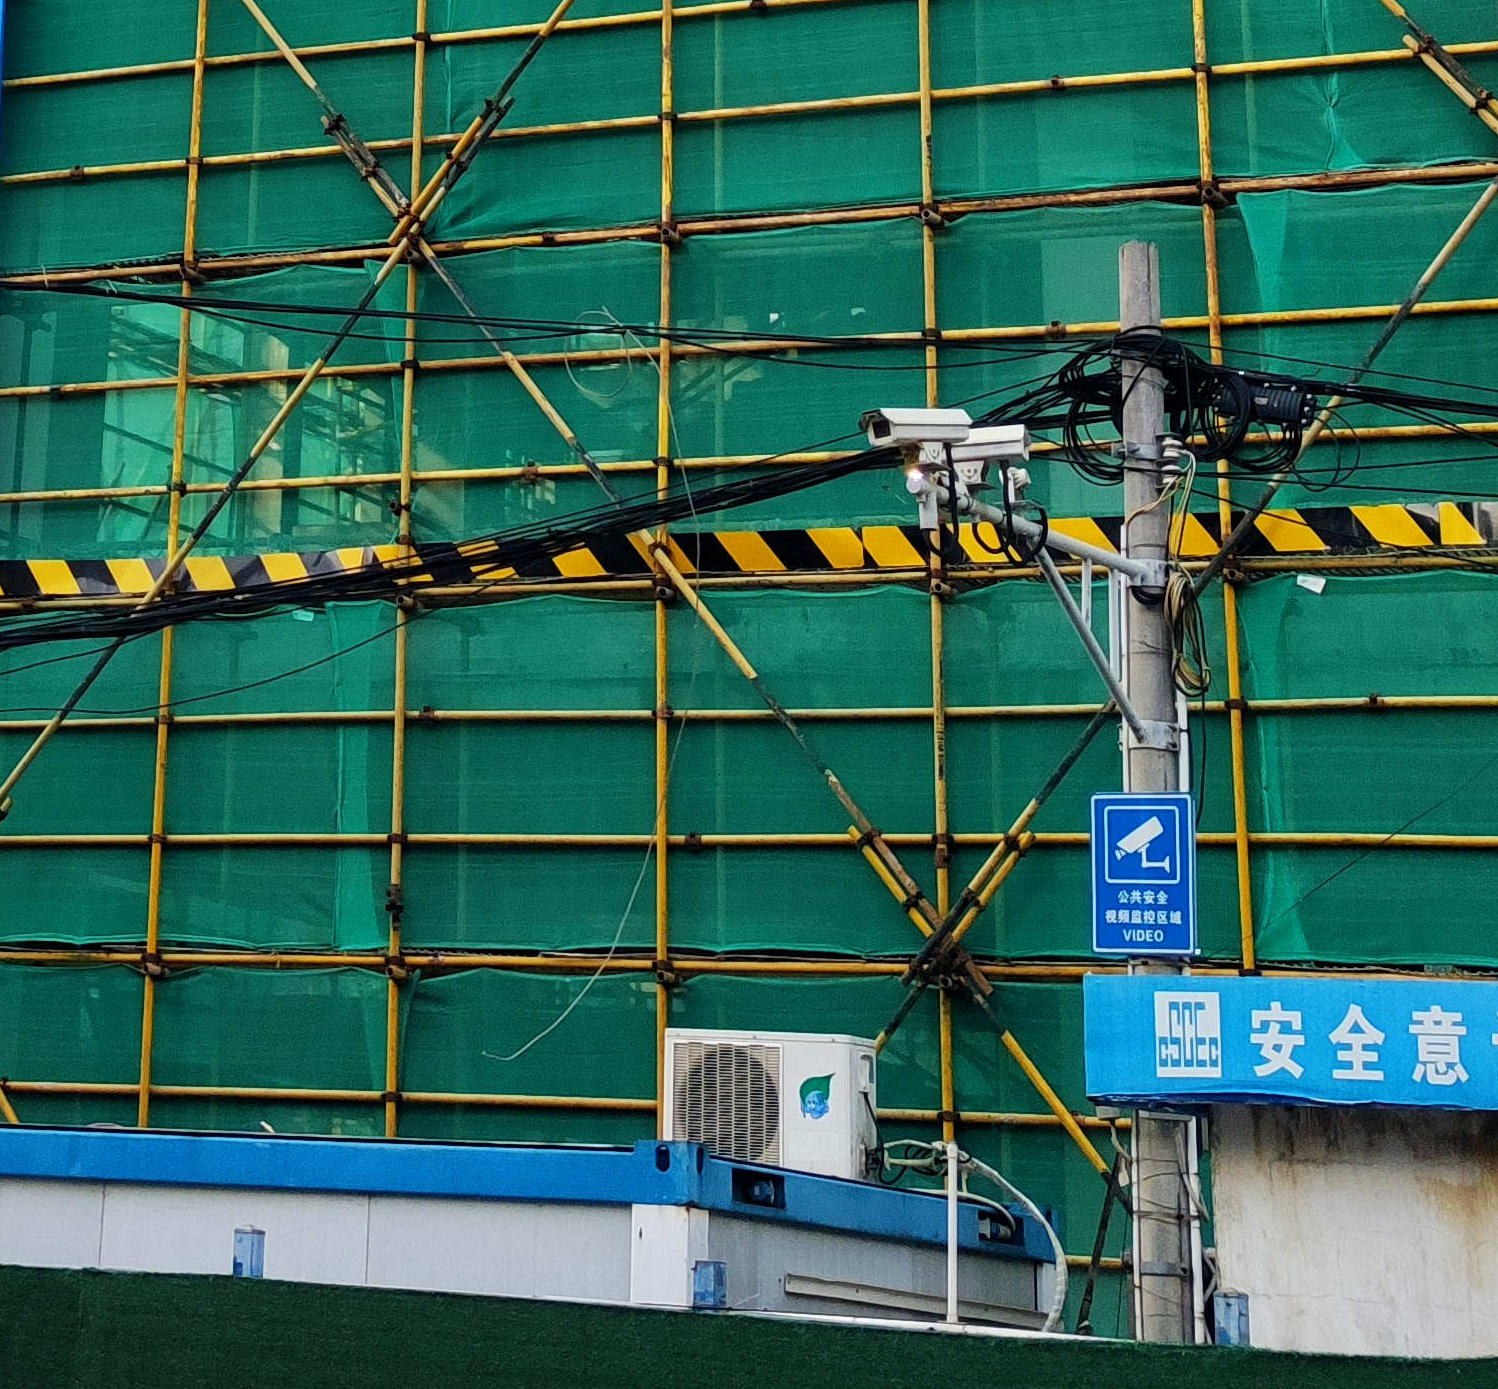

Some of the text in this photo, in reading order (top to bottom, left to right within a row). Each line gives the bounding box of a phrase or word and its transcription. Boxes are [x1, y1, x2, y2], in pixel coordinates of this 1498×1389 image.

[1117, 890, 1168, 905] 公共安全
[1105, 910, 1182, 925] 视频监控区域
[1123, 929, 1164, 942] VIDEO
